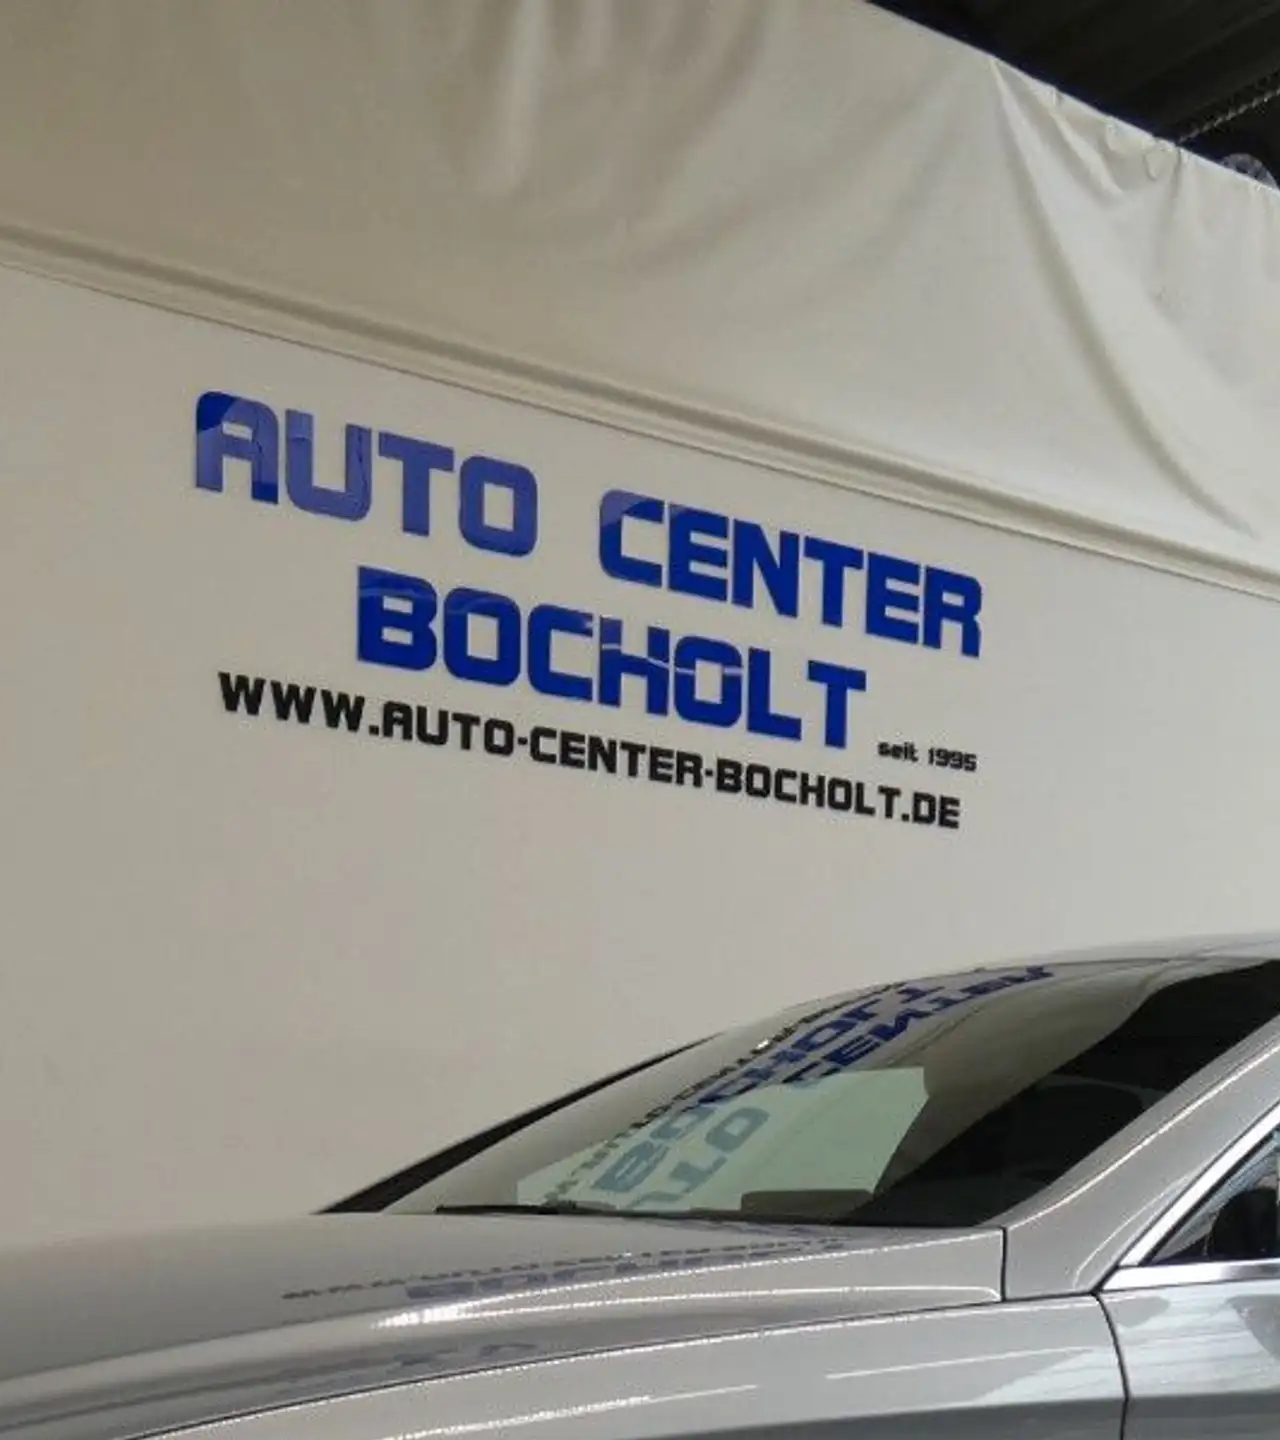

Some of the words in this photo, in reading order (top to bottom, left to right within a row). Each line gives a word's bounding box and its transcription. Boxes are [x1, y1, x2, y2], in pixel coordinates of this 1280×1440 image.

[195, 391, 537, 557] AUTO
[599, 490, 983, 658] CENTER
[356, 566, 867, 749] BOCHOLT
[877, 741, 919, 763] seit
[928, 747, 977, 773] 1995
